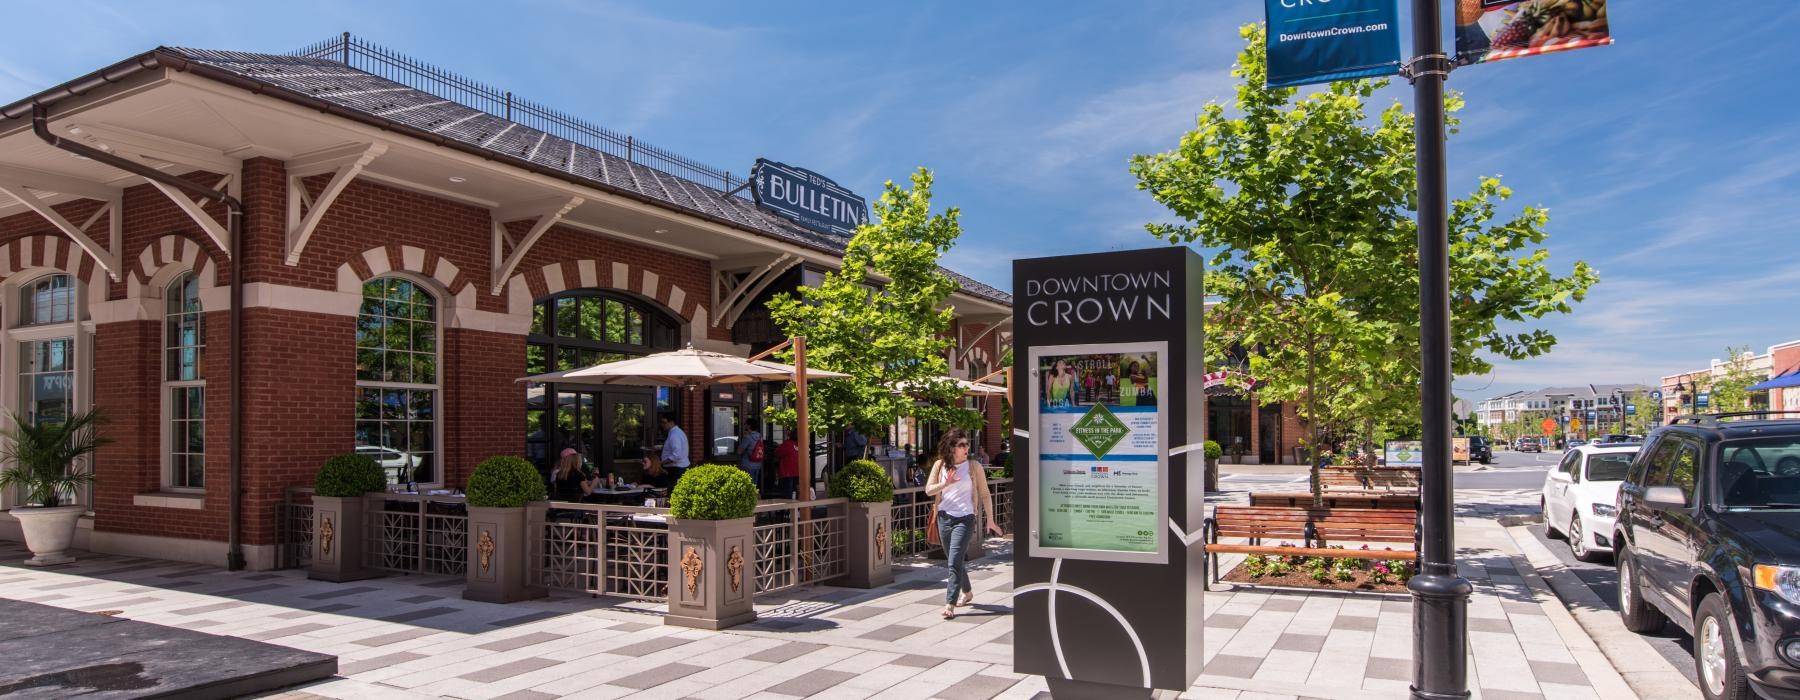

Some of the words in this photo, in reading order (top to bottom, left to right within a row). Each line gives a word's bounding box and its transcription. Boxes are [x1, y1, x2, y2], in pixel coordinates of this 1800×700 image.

[1279, 23, 1388, 42] DowntownCrown.com
[809, 174, 826, 189] TED'S
[769, 174, 860, 226] BULLETIN
[1026, 270, 1170, 297] DOWNTOWN
[1027, 293, 1170, 326] CROWN
[1077, 359, 1113, 370] STROLL
[1119, 386, 1153, 397] ZUMBA
